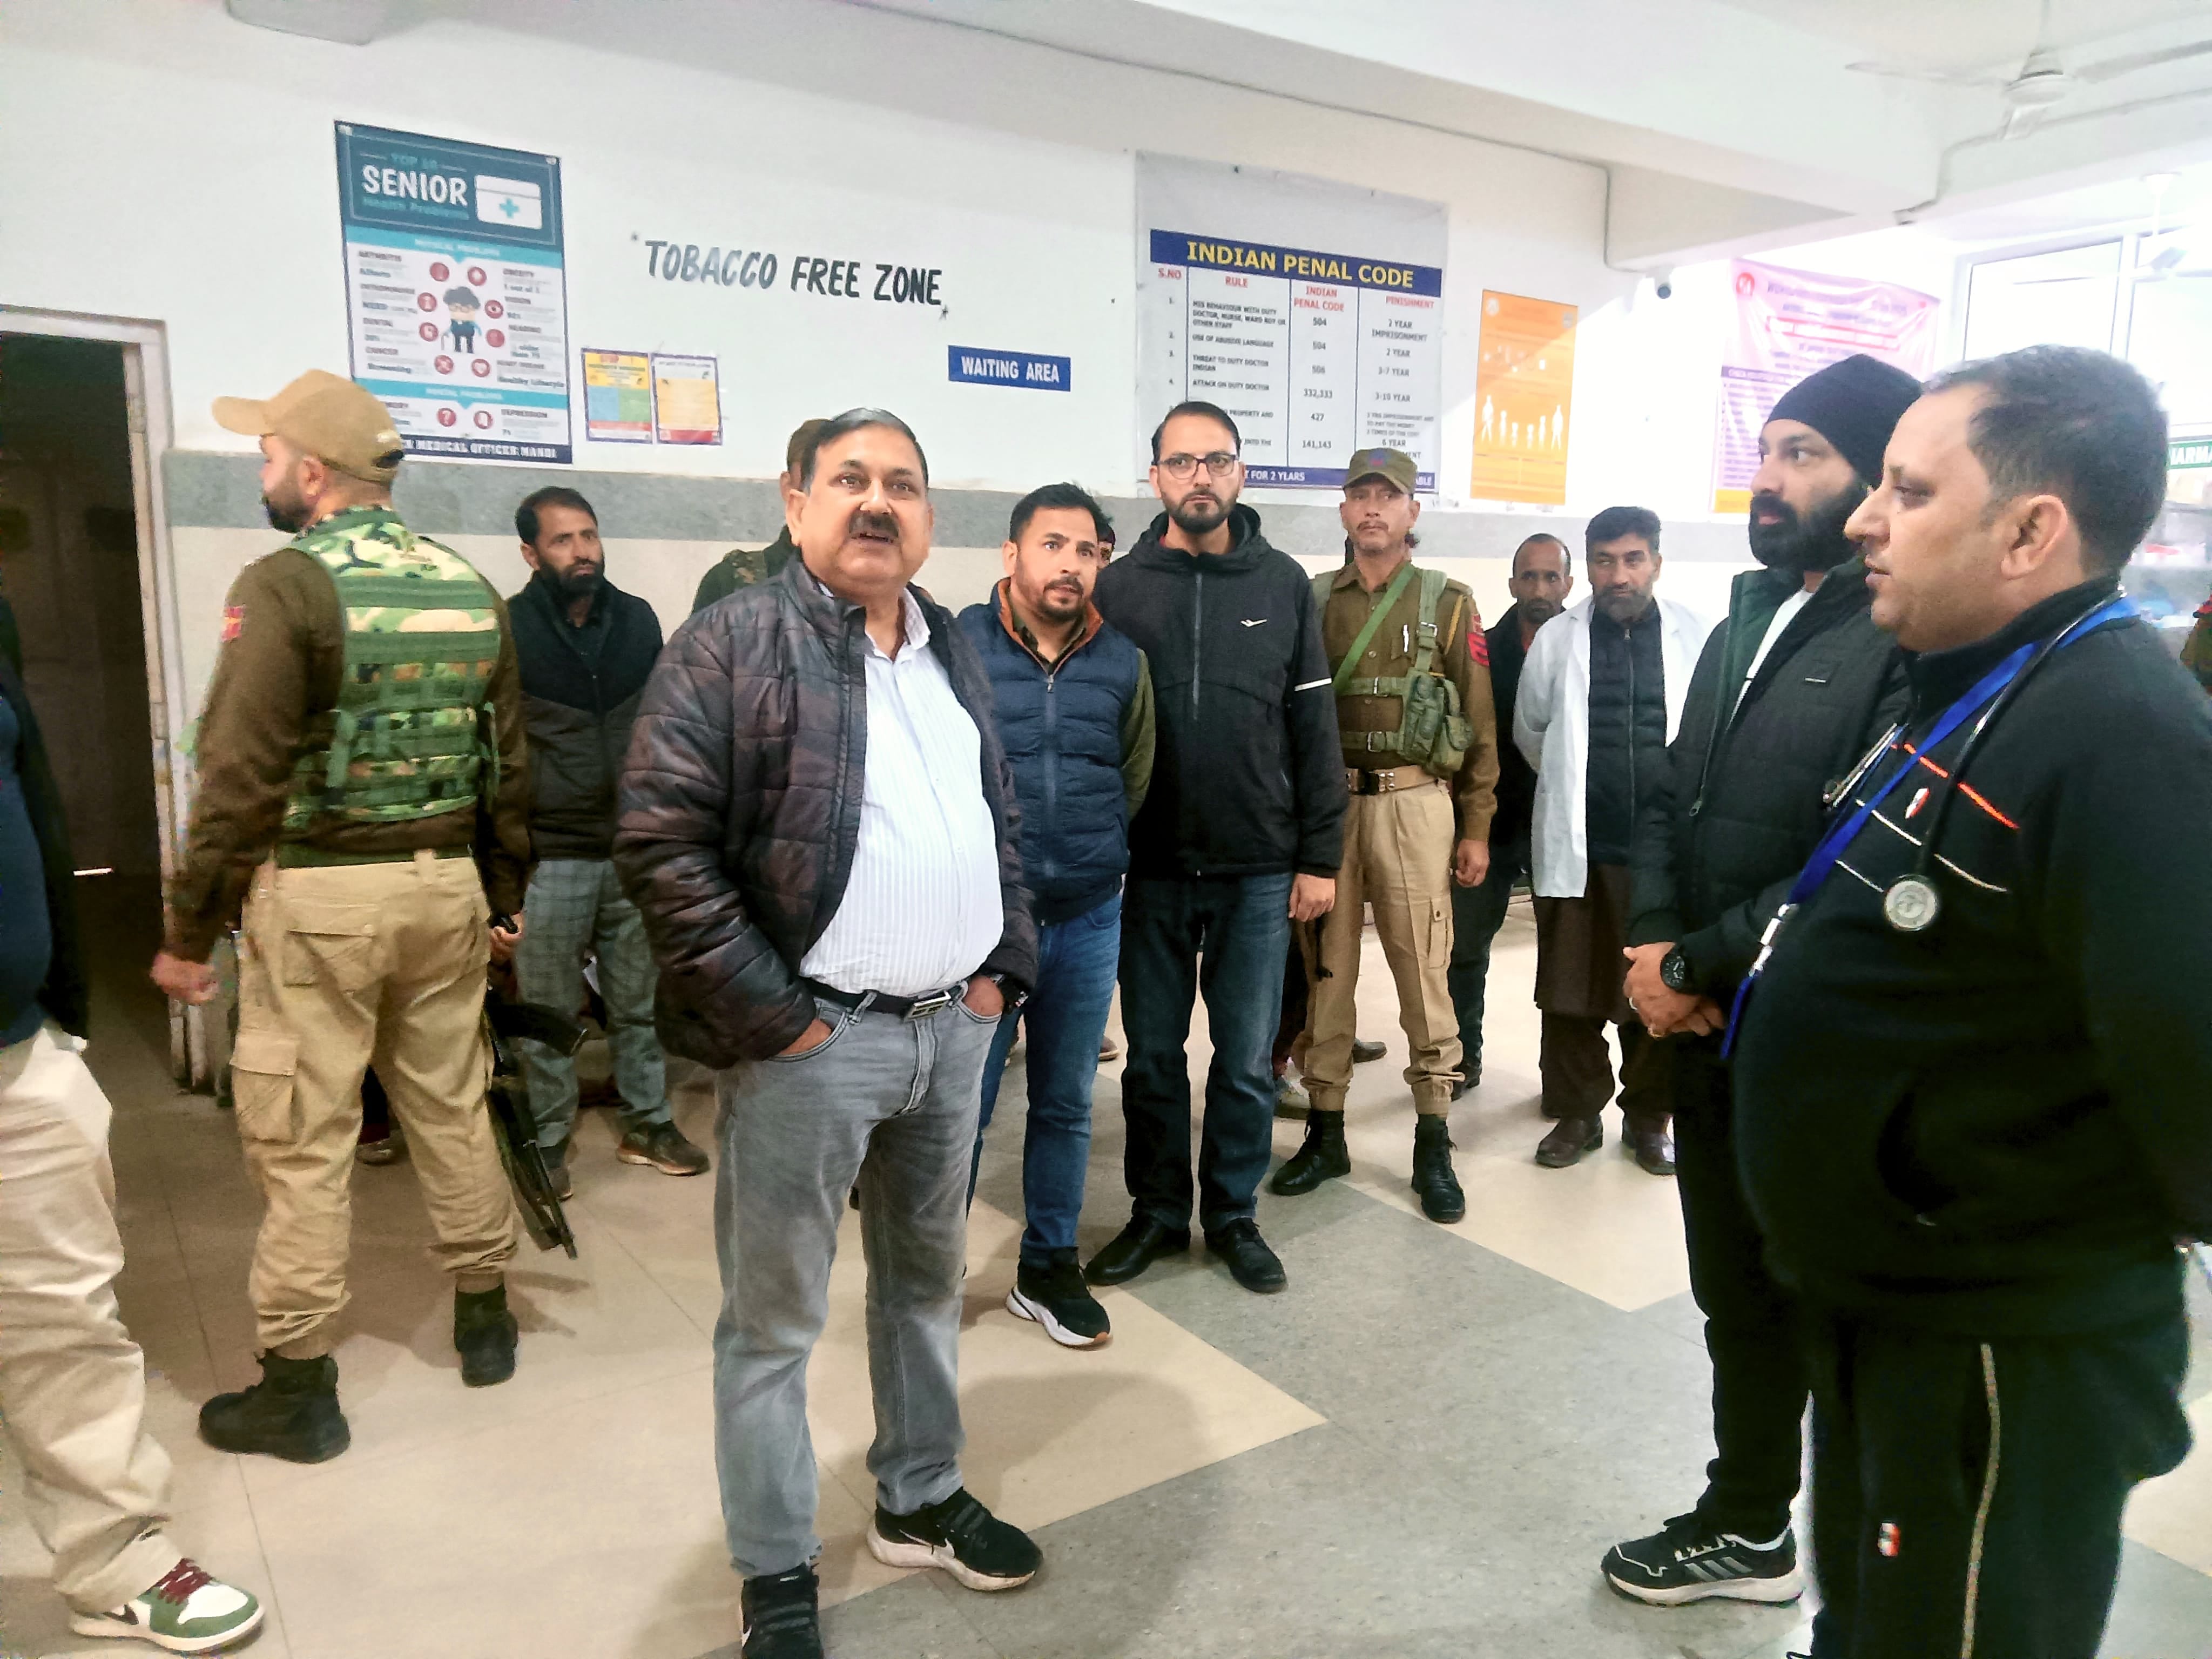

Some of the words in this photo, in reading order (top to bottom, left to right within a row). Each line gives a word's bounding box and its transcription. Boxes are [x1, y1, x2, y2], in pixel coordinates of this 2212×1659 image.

[362, 164, 468, 207] SENIOR
[1187, 241, 1276, 271] INDIAN
[1284, 254, 1352, 281] PENAL
[1358, 265, 1414, 288] CODE
[645, 240, 778, 289] TOBACCO
[790, 256, 861, 298] FREE
[873, 263, 942, 306] ZONE
[1158, 267, 1182, 280] S.NO
[1225, 276, 1248, 288] RULE
[1306, 285, 1337, 297] INDIAN
[1294, 297, 1320, 309] PENAL
[1323, 300, 1344, 312] CODE
[1313, 317, 1327, 326] 504
[1394, 320, 1412, 328] YEAR
[1372, 329, 1427, 342] IMPRISONMENT
[1313, 341, 1326, 350] 504
[1393, 349, 1410, 358] YEAR
[1245, 359, 1269, 367] DOCTOR
[961, 356, 1019, 379] WAITING
[1026, 362, 1060, 384] AREA
[1392, 368, 1410, 376] YEAR
[1393, 394, 1411, 402] YEAR
[1230, 409, 1260, 417] PROPERTY
[1311, 413, 1325, 421] 427
[1251, 470, 1268, 480] FOR
[1270, 471, 1276, 481] 2
[1278, 471, 1305, 481] YEARS
